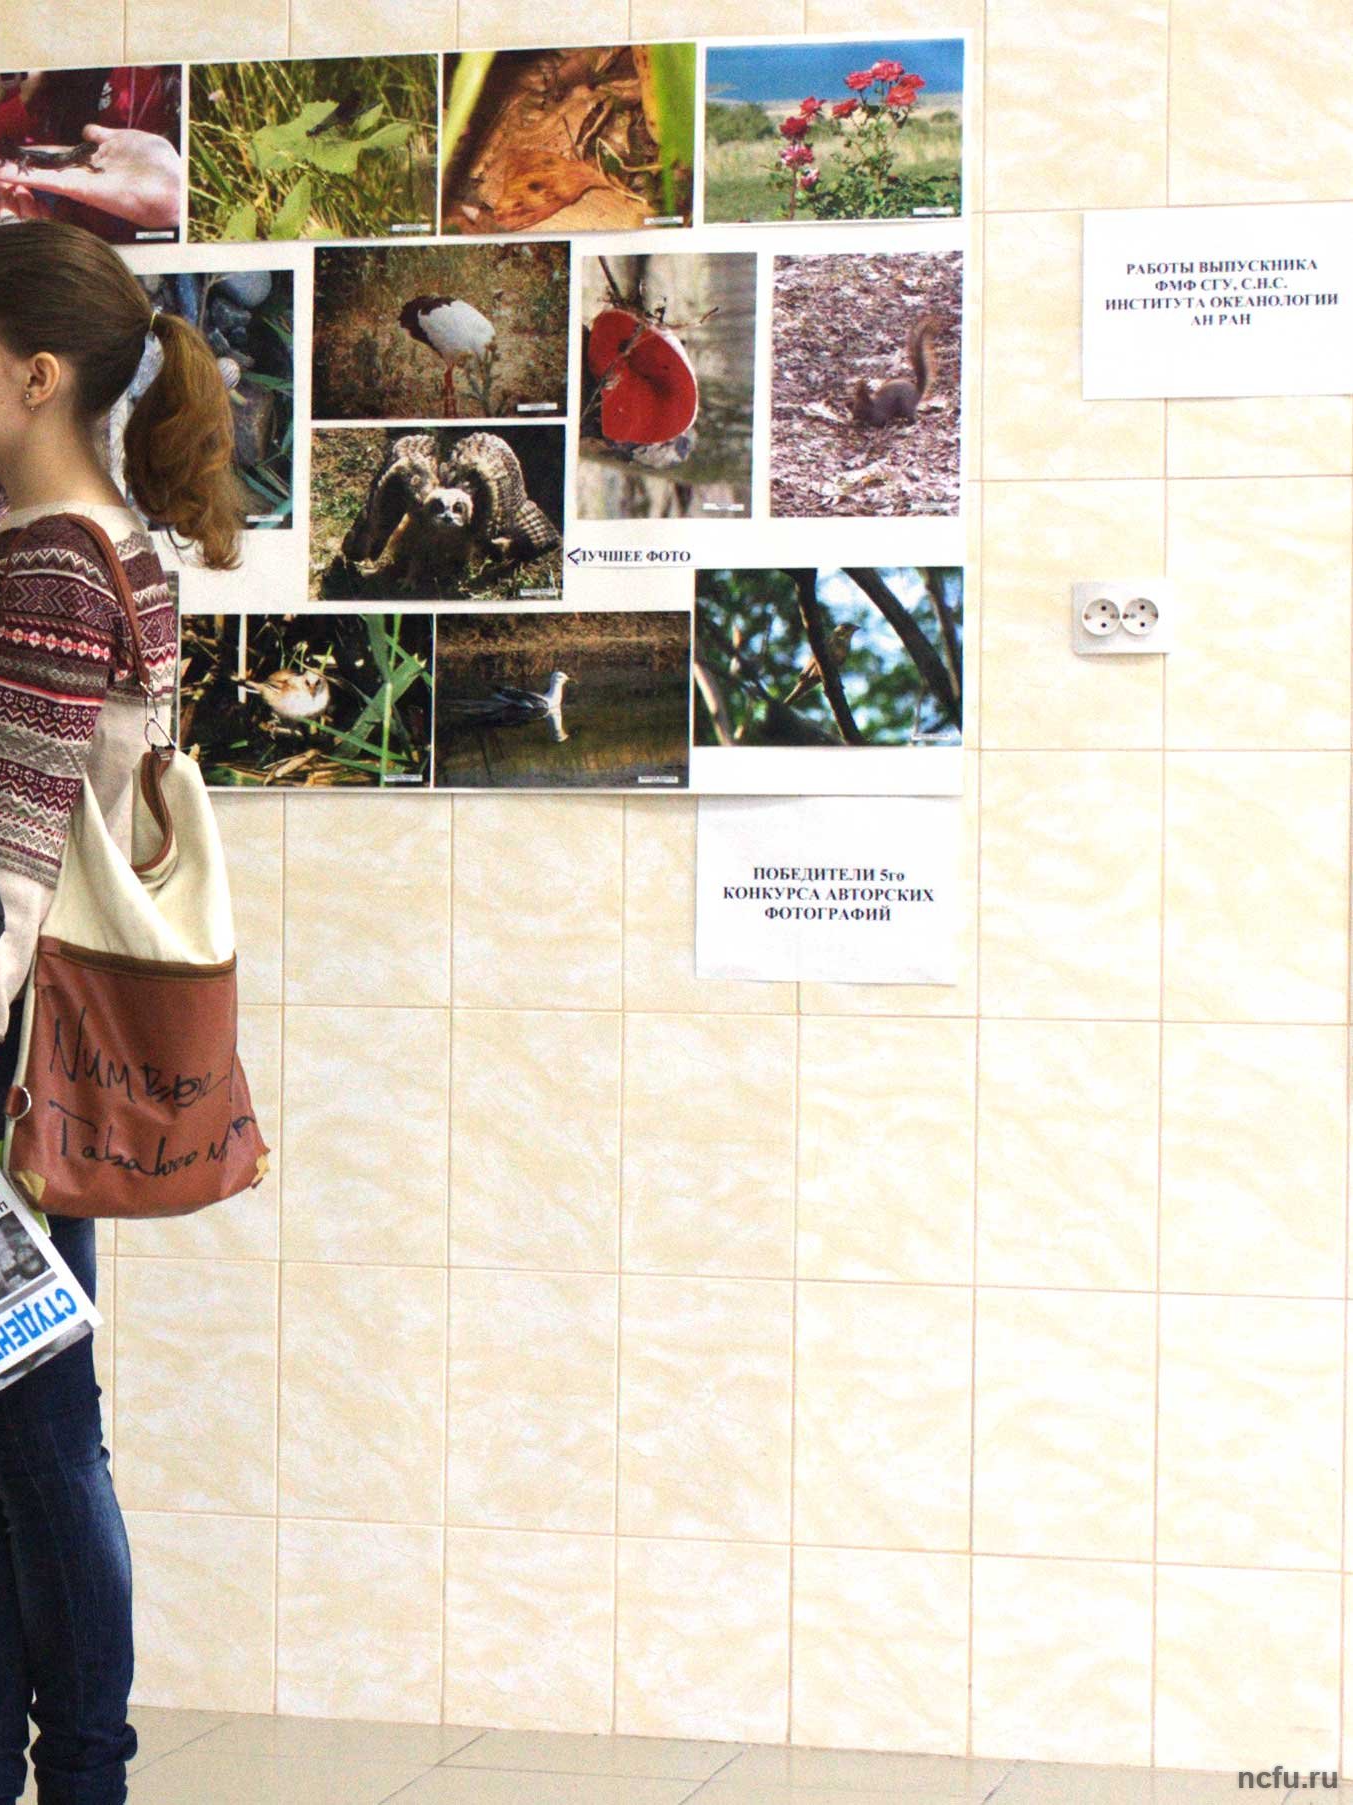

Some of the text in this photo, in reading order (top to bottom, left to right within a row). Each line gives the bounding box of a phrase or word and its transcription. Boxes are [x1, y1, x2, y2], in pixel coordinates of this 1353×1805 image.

[1126, 259, 1318, 275] РАБОТЫ ВЫПУСКНИКА
[1155, 280, 1196, 292] ФМФ
[1105, 293, 1339, 311] ИНСТИТУТА ОКЕАНОЛОГИИ
[1191, 314, 1251, 326] АН РАН
[646, 550, 691, 562] ФОТО
[753, 867, 905, 882] ПОБЕДИТЕЛИ 5го
[723, 886, 934, 902] КОНКУРСА АВТОРСКИХ
[764, 906, 892, 921] ФОТОГРАФИЙ
